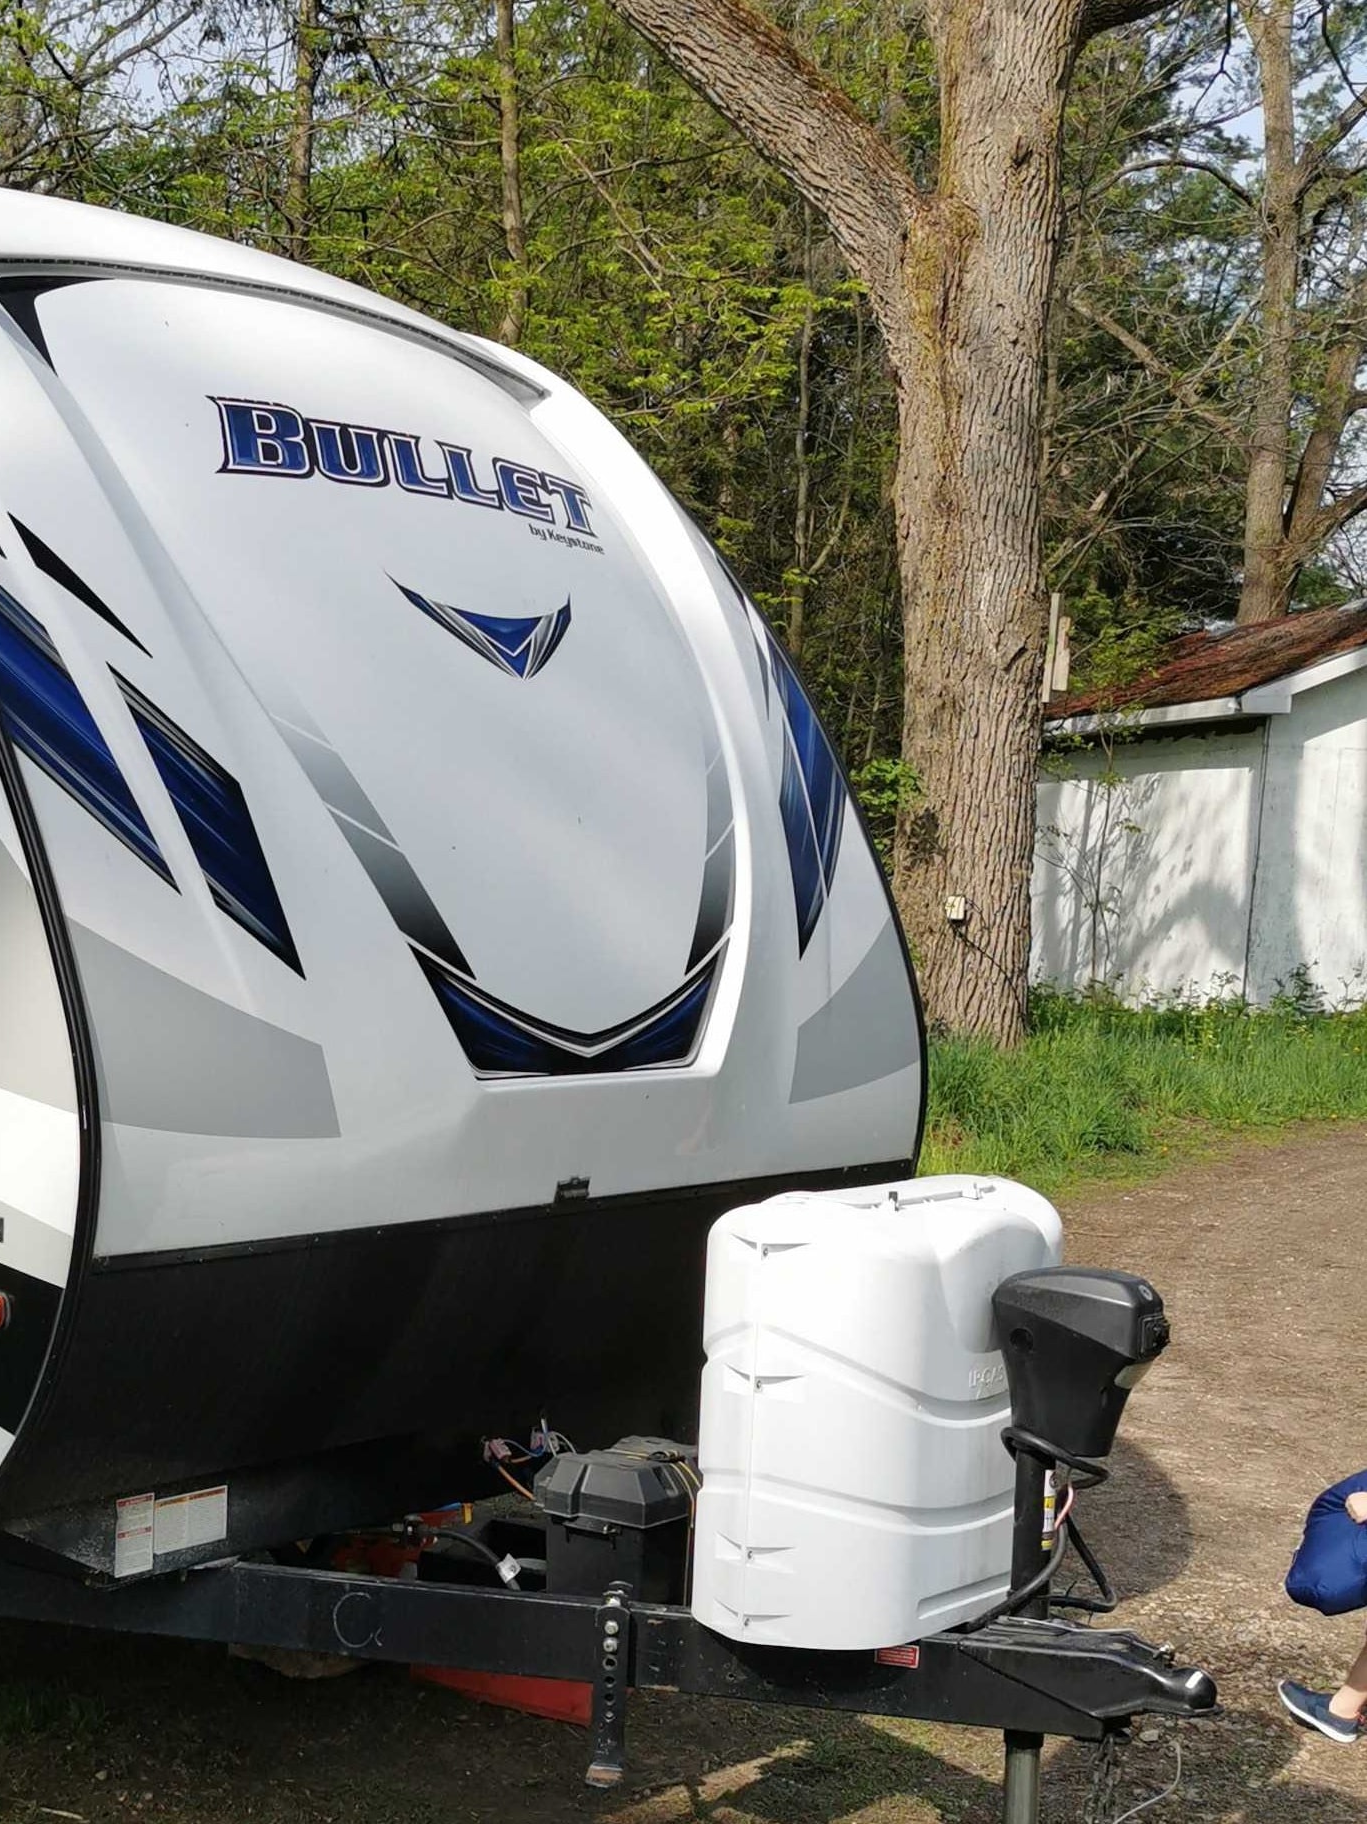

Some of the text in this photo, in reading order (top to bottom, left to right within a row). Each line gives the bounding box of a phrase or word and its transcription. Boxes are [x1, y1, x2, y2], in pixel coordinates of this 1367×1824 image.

[205, 395, 598, 538] BULLET
[528, 523, 605, 555] by Keystone
